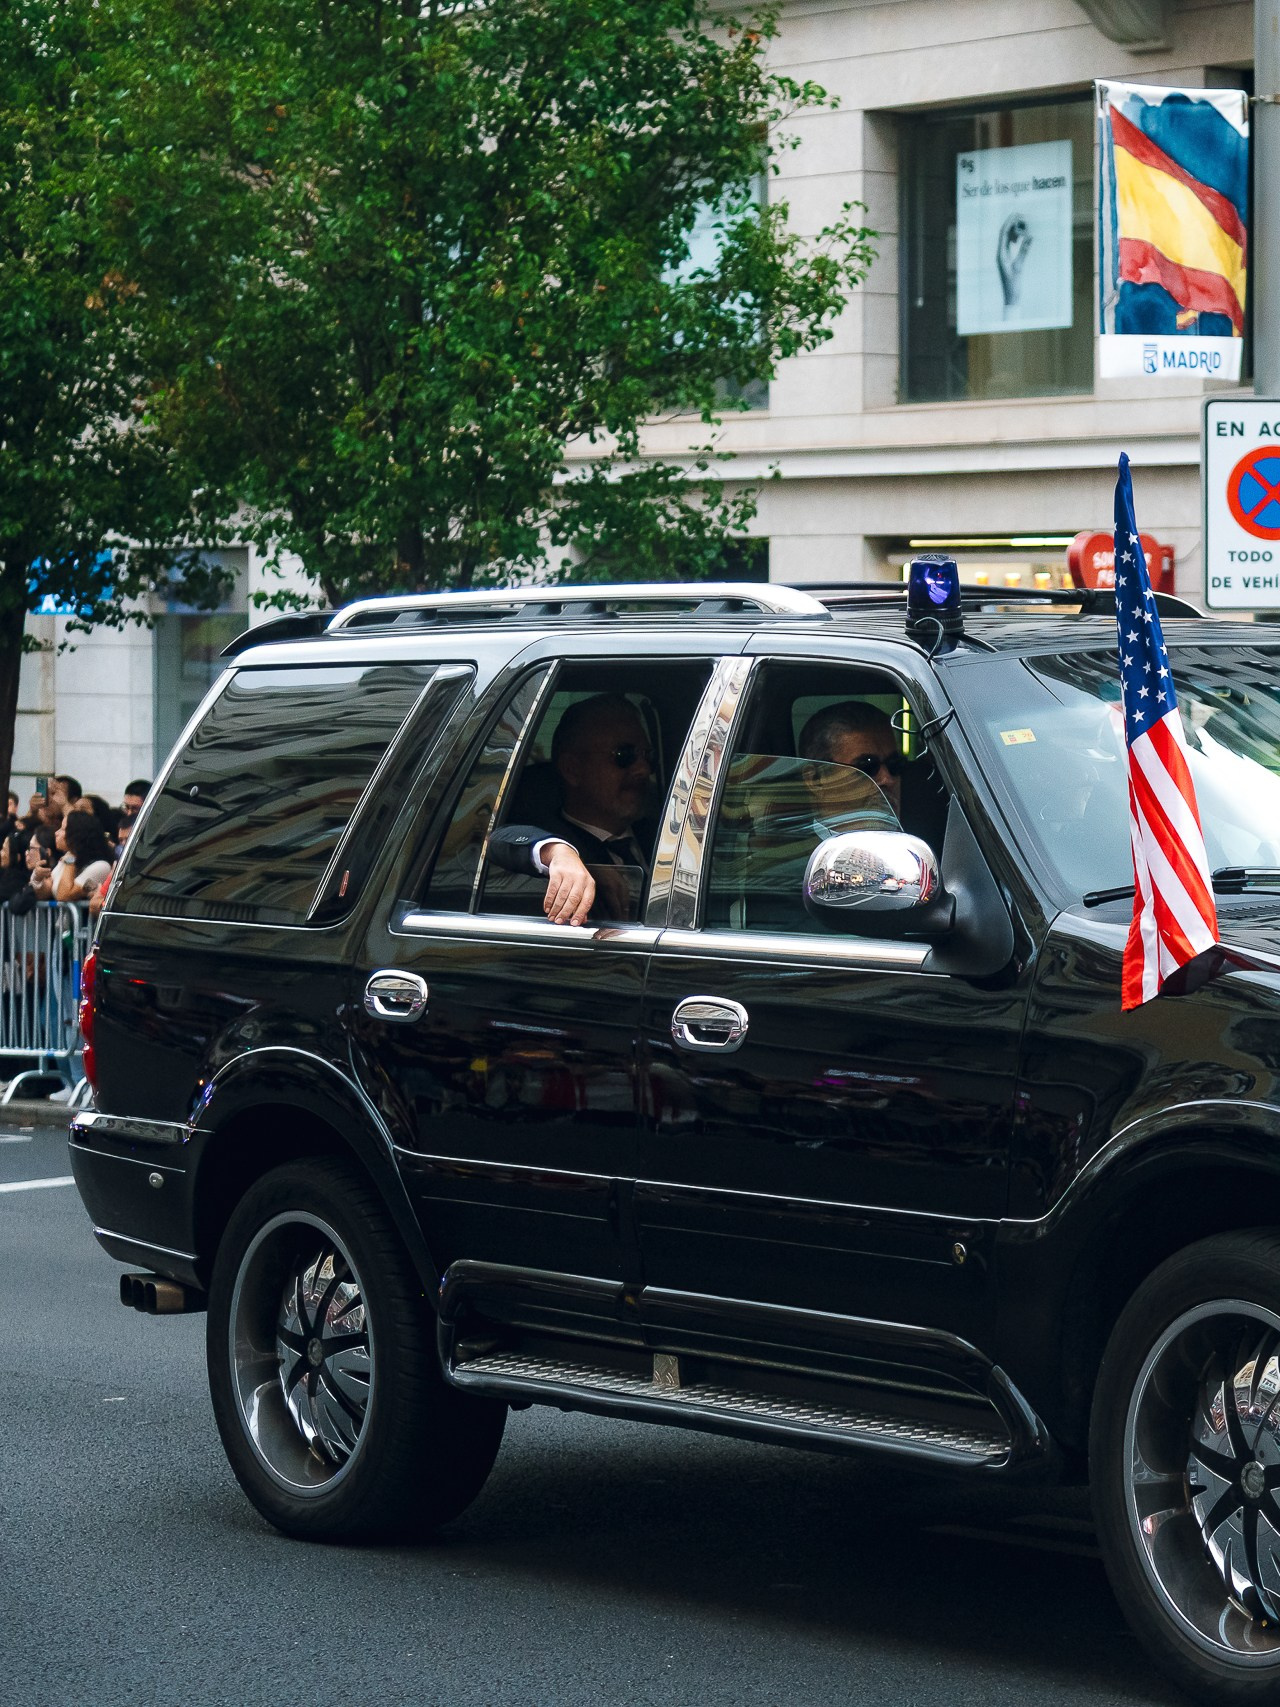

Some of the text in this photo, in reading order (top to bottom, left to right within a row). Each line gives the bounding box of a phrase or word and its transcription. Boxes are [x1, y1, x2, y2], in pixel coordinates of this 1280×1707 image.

[1032, 176, 1066, 190] hacen
[1163, 350, 1222, 374] MADRID
[1215, 421, 1245, 437] EN
[1228, 550, 1274, 563] TODO
[1211, 576, 1232, 589] DE
